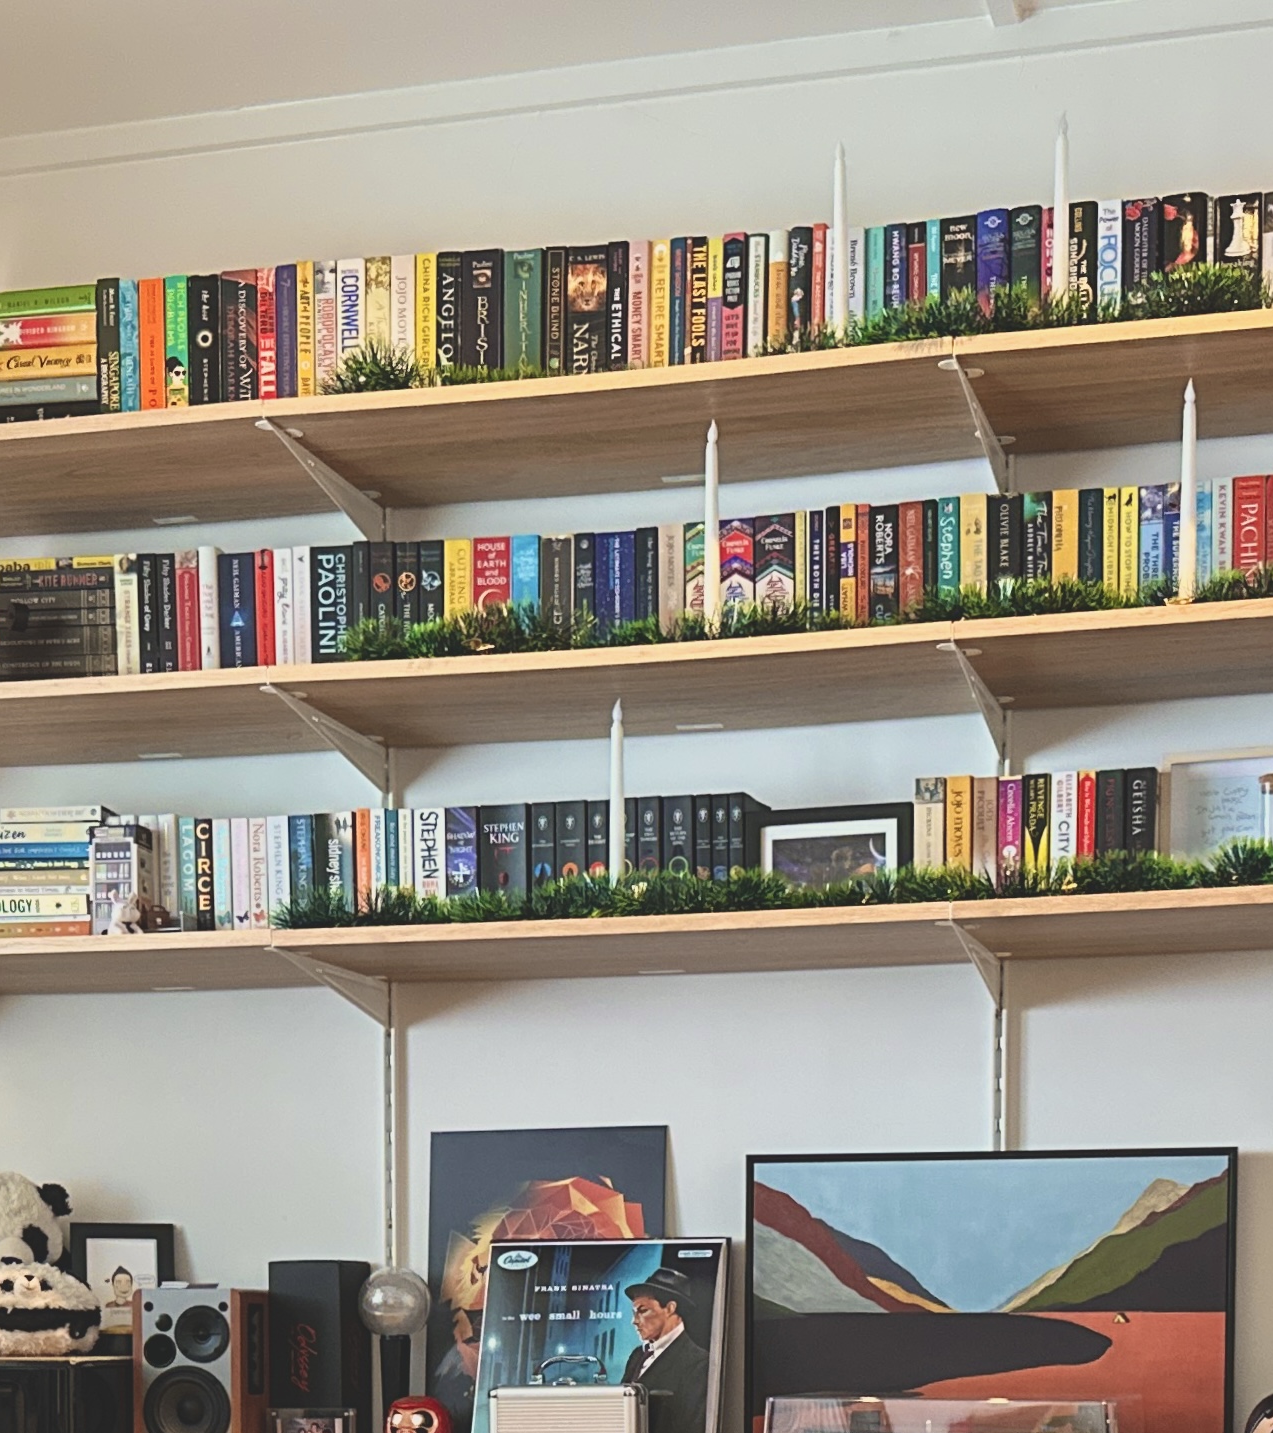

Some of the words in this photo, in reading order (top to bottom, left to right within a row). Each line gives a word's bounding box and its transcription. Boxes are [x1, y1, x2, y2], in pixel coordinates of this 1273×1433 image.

[692, 245, 706, 268] THE
[280, 278, 291, 287] 7
[422, 258, 431, 293] CHINA
[551, 267, 559, 303] STONE
[692, 273, 706, 303] LAST
[849, 268, 857, 298] Brown
[341, 275, 359, 353] CORNWELL
[422, 296, 430, 323] RICH
[551, 306, 560, 340] BLIND
[631, 291, 642, 325] MONEY
[611, 303, 622, 360] ETHICAL
[691, 309, 705, 347] FOOLS
[108, 351, 120, 410] SINGAPORE
[260, 351, 276, 396] FALL
[1218, 484, 1227, 519] KEVIN
[906, 509, 915, 529] NEIL
[999, 503, 1008, 535] OLIVIE
[875, 514, 884, 565] ROBERTS
[884, 522, 893, 555] NORA
[907, 530, 916, 562] GAIMAN
[974, 538, 983, 556] THE
[999, 538, 1009, 567] BLAKE
[1026, 523, 1034, 552] AUDREY
[1125, 535, 1132, 547] TO
[1218, 522, 1227, 555] KWAN
[39, 574, 58, 588] KITE
[60, 573, 97, 587] RUNNER
[162, 559, 170, 576] Fifty
[232, 559, 240, 576] NEIL
[457, 548, 467, 604] CUTTING
[974, 560, 983, 578] TAO
[163, 577, 171, 603] Shades
[232, 578, 240, 609] GAIMAN
[318, 555, 336, 654] PAOLINI
[163, 604, 171, 629] Darker
[234, 630, 242, 668] AMERICAN
[951, 789, 963, 814] jojo
[1007, 783, 1016, 814] Cecelia
[1132, 779, 1142, 835] GEISHA
[253, 823, 264, 853] Nora
[296, 818, 306, 864] STEPHEN
[483, 822, 524, 833] STEPHEN
[489, 833, 519, 844] KING
[953, 817, 963, 857] moyes
[1006, 815, 1015, 842] Ahern
[1058, 820, 1069, 853] CITY
[182, 824, 194, 891] LAGOM
[326, 839, 342, 874] sidney
[374, 815, 382, 883] FREAKONOMICS
[420, 811, 440, 879] STEPHEN
[196, 823, 211, 910] CIRCE
[253, 857, 264, 901] Roberts
[275, 870, 283, 895] KING
[298, 865, 307, 890] KING
[503, 1255, 532, 1265] Capitol
[519, 1312, 541, 1321] wee
[548, 1310, 581, 1320] small
[589, 1310, 623, 1320] hours
[288, 1324, 318, 1392] Odyssey
